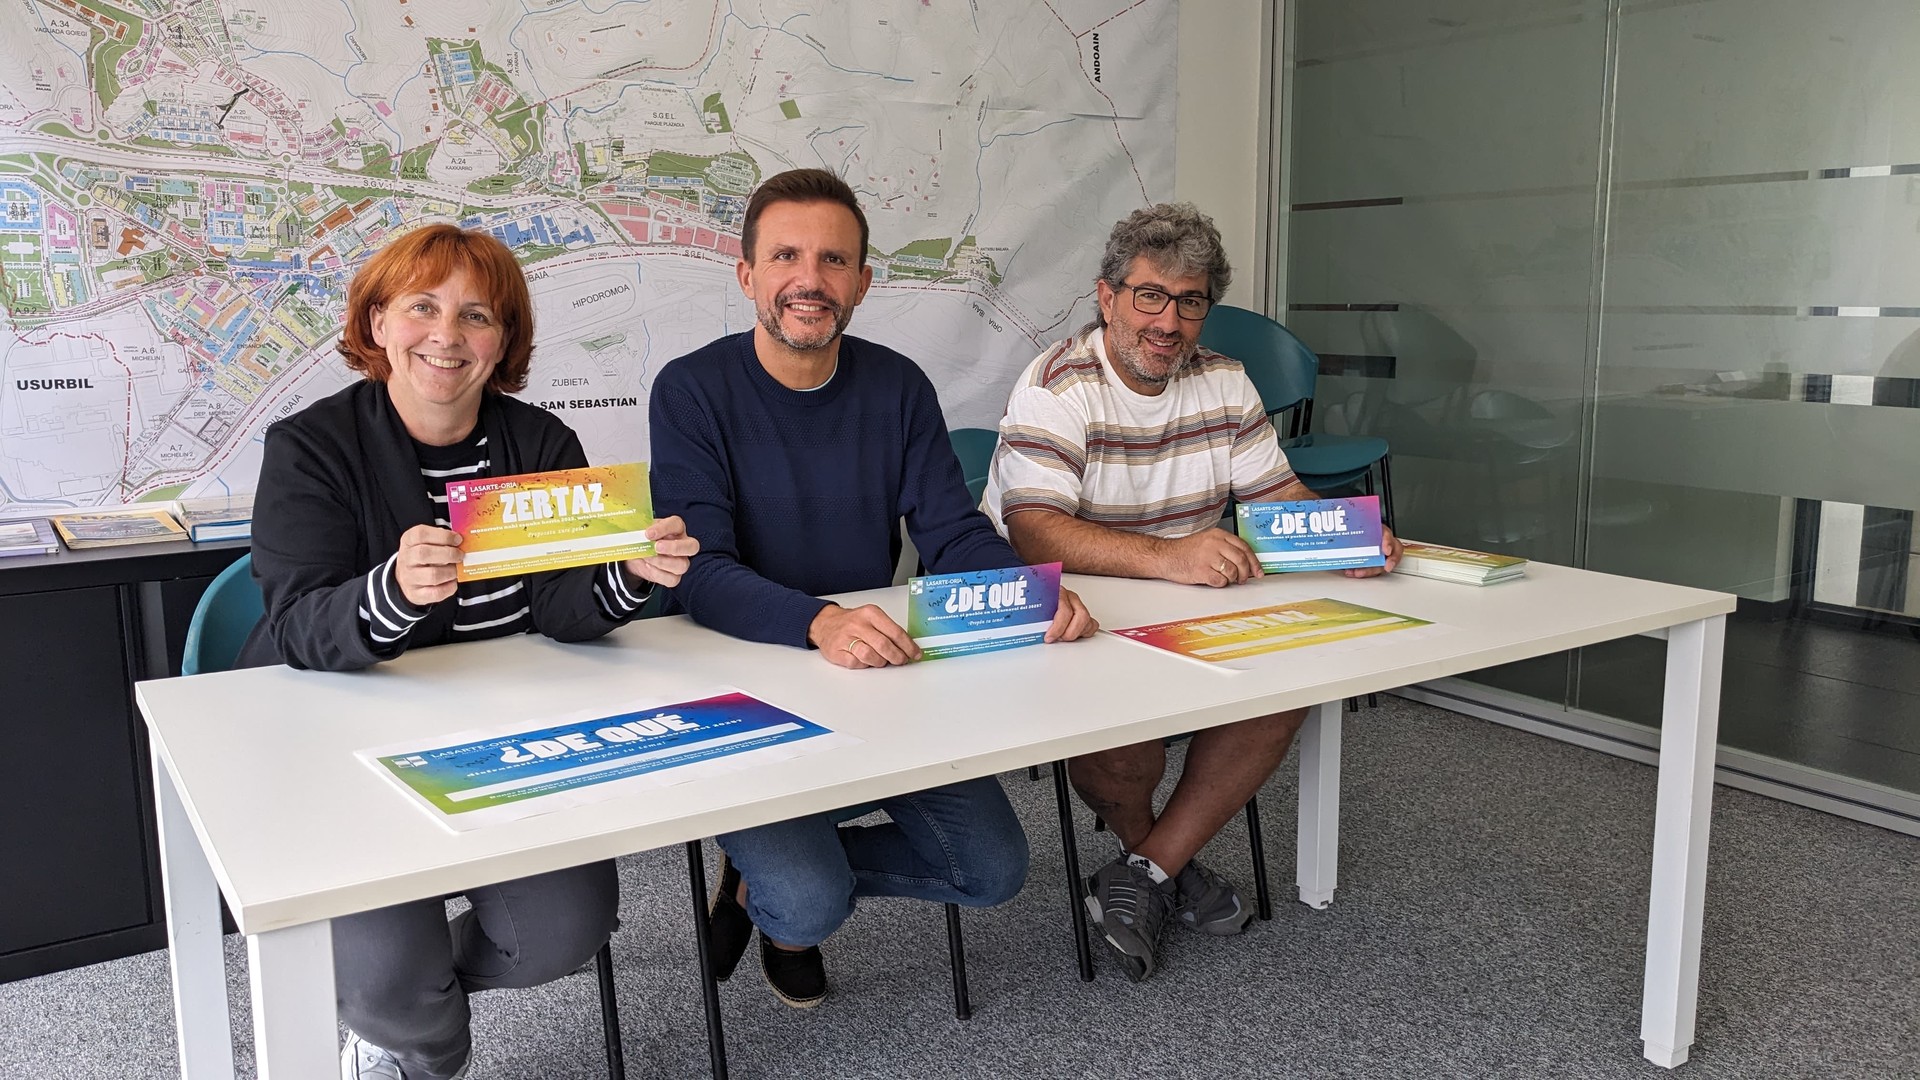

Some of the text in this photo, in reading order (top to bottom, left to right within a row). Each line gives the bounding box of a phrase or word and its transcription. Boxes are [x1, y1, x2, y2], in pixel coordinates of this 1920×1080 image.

[50, 20, 70, 28] A.34
[66, 28, 88, 37] GOIEGI
[1092, 33, 1101, 83] ANDOAIN
[572, 284, 630, 308] HIPODROMOA
[988, 318, 1002, 332] ORIA
[17, 378, 94, 390] USURBIL
[552, 378, 590, 386] ZUBIETA
[280, 394, 303, 415] IBAIA
[540, 400, 565, 410] SAN
[570, 398, 637, 409] SEBASTIAN
[470, 482, 517, 492] LASARTE-ORIA
[500, 483, 604, 523] ZERTAZ
[1271, 506, 1347, 535] ¿DE QUÉ
[945, 576, 1027, 614] ¿DE QUÉ
[500, 732, 603, 763] ¿DE
[595, 713, 700, 742] QUÉ
[639, 741, 666, 749] tema!
[430, 738, 520, 758] LASARTE-ORIA
[563, 747, 605, 758] pueblo
